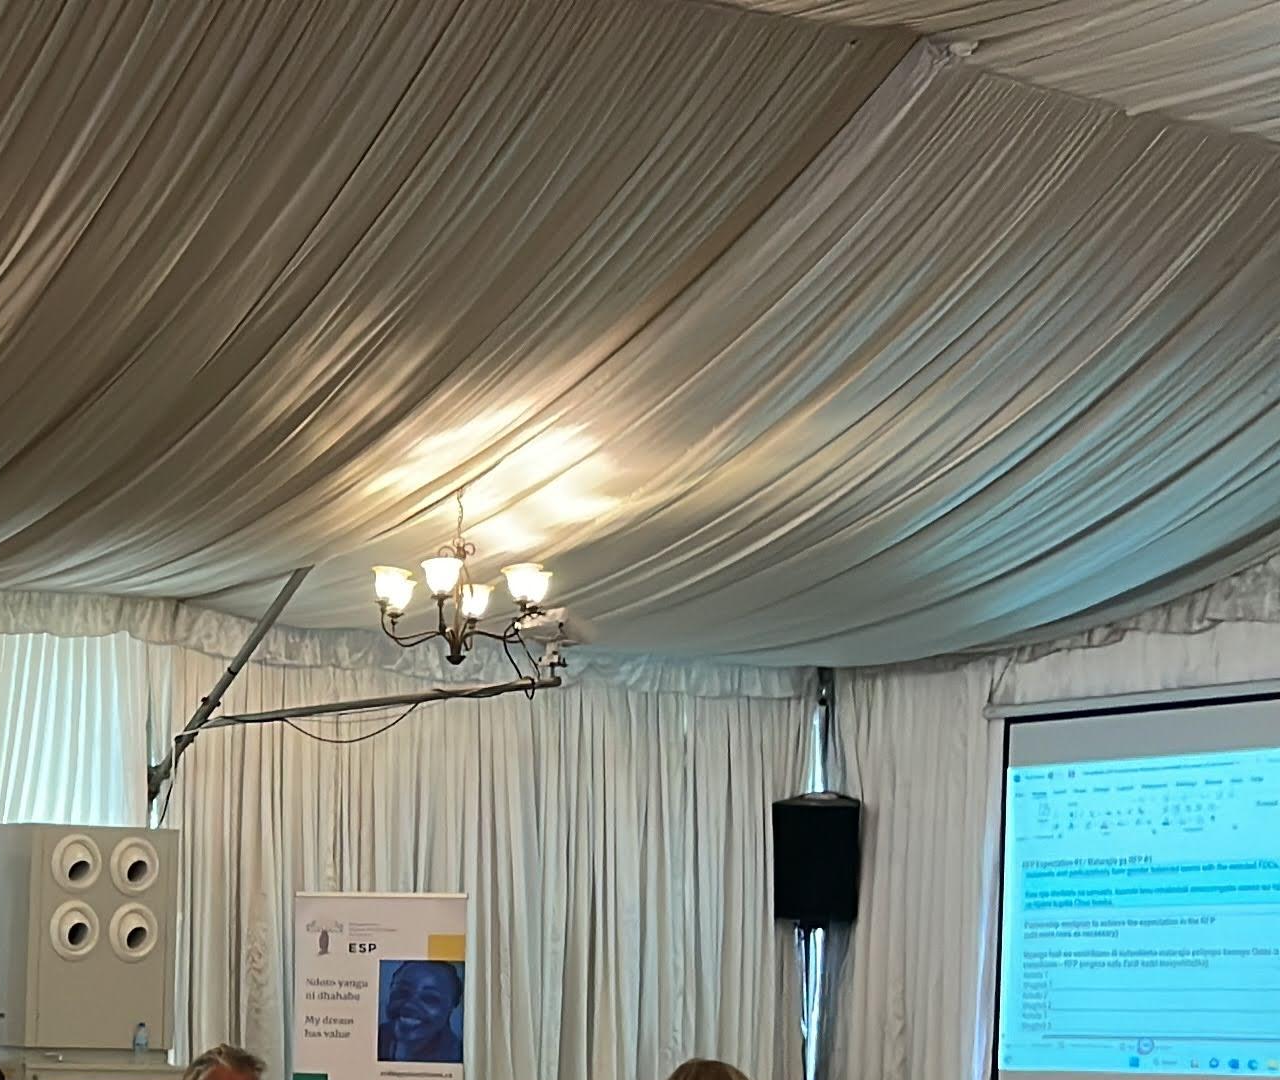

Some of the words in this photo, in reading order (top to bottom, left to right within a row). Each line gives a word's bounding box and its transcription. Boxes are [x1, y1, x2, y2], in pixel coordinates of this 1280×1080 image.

[348, 942, 378, 954] ESP
[304, 1015, 321, 1026] My
[322, 1015, 354, 1025] dream
[304, 1028, 322, 1038] has
